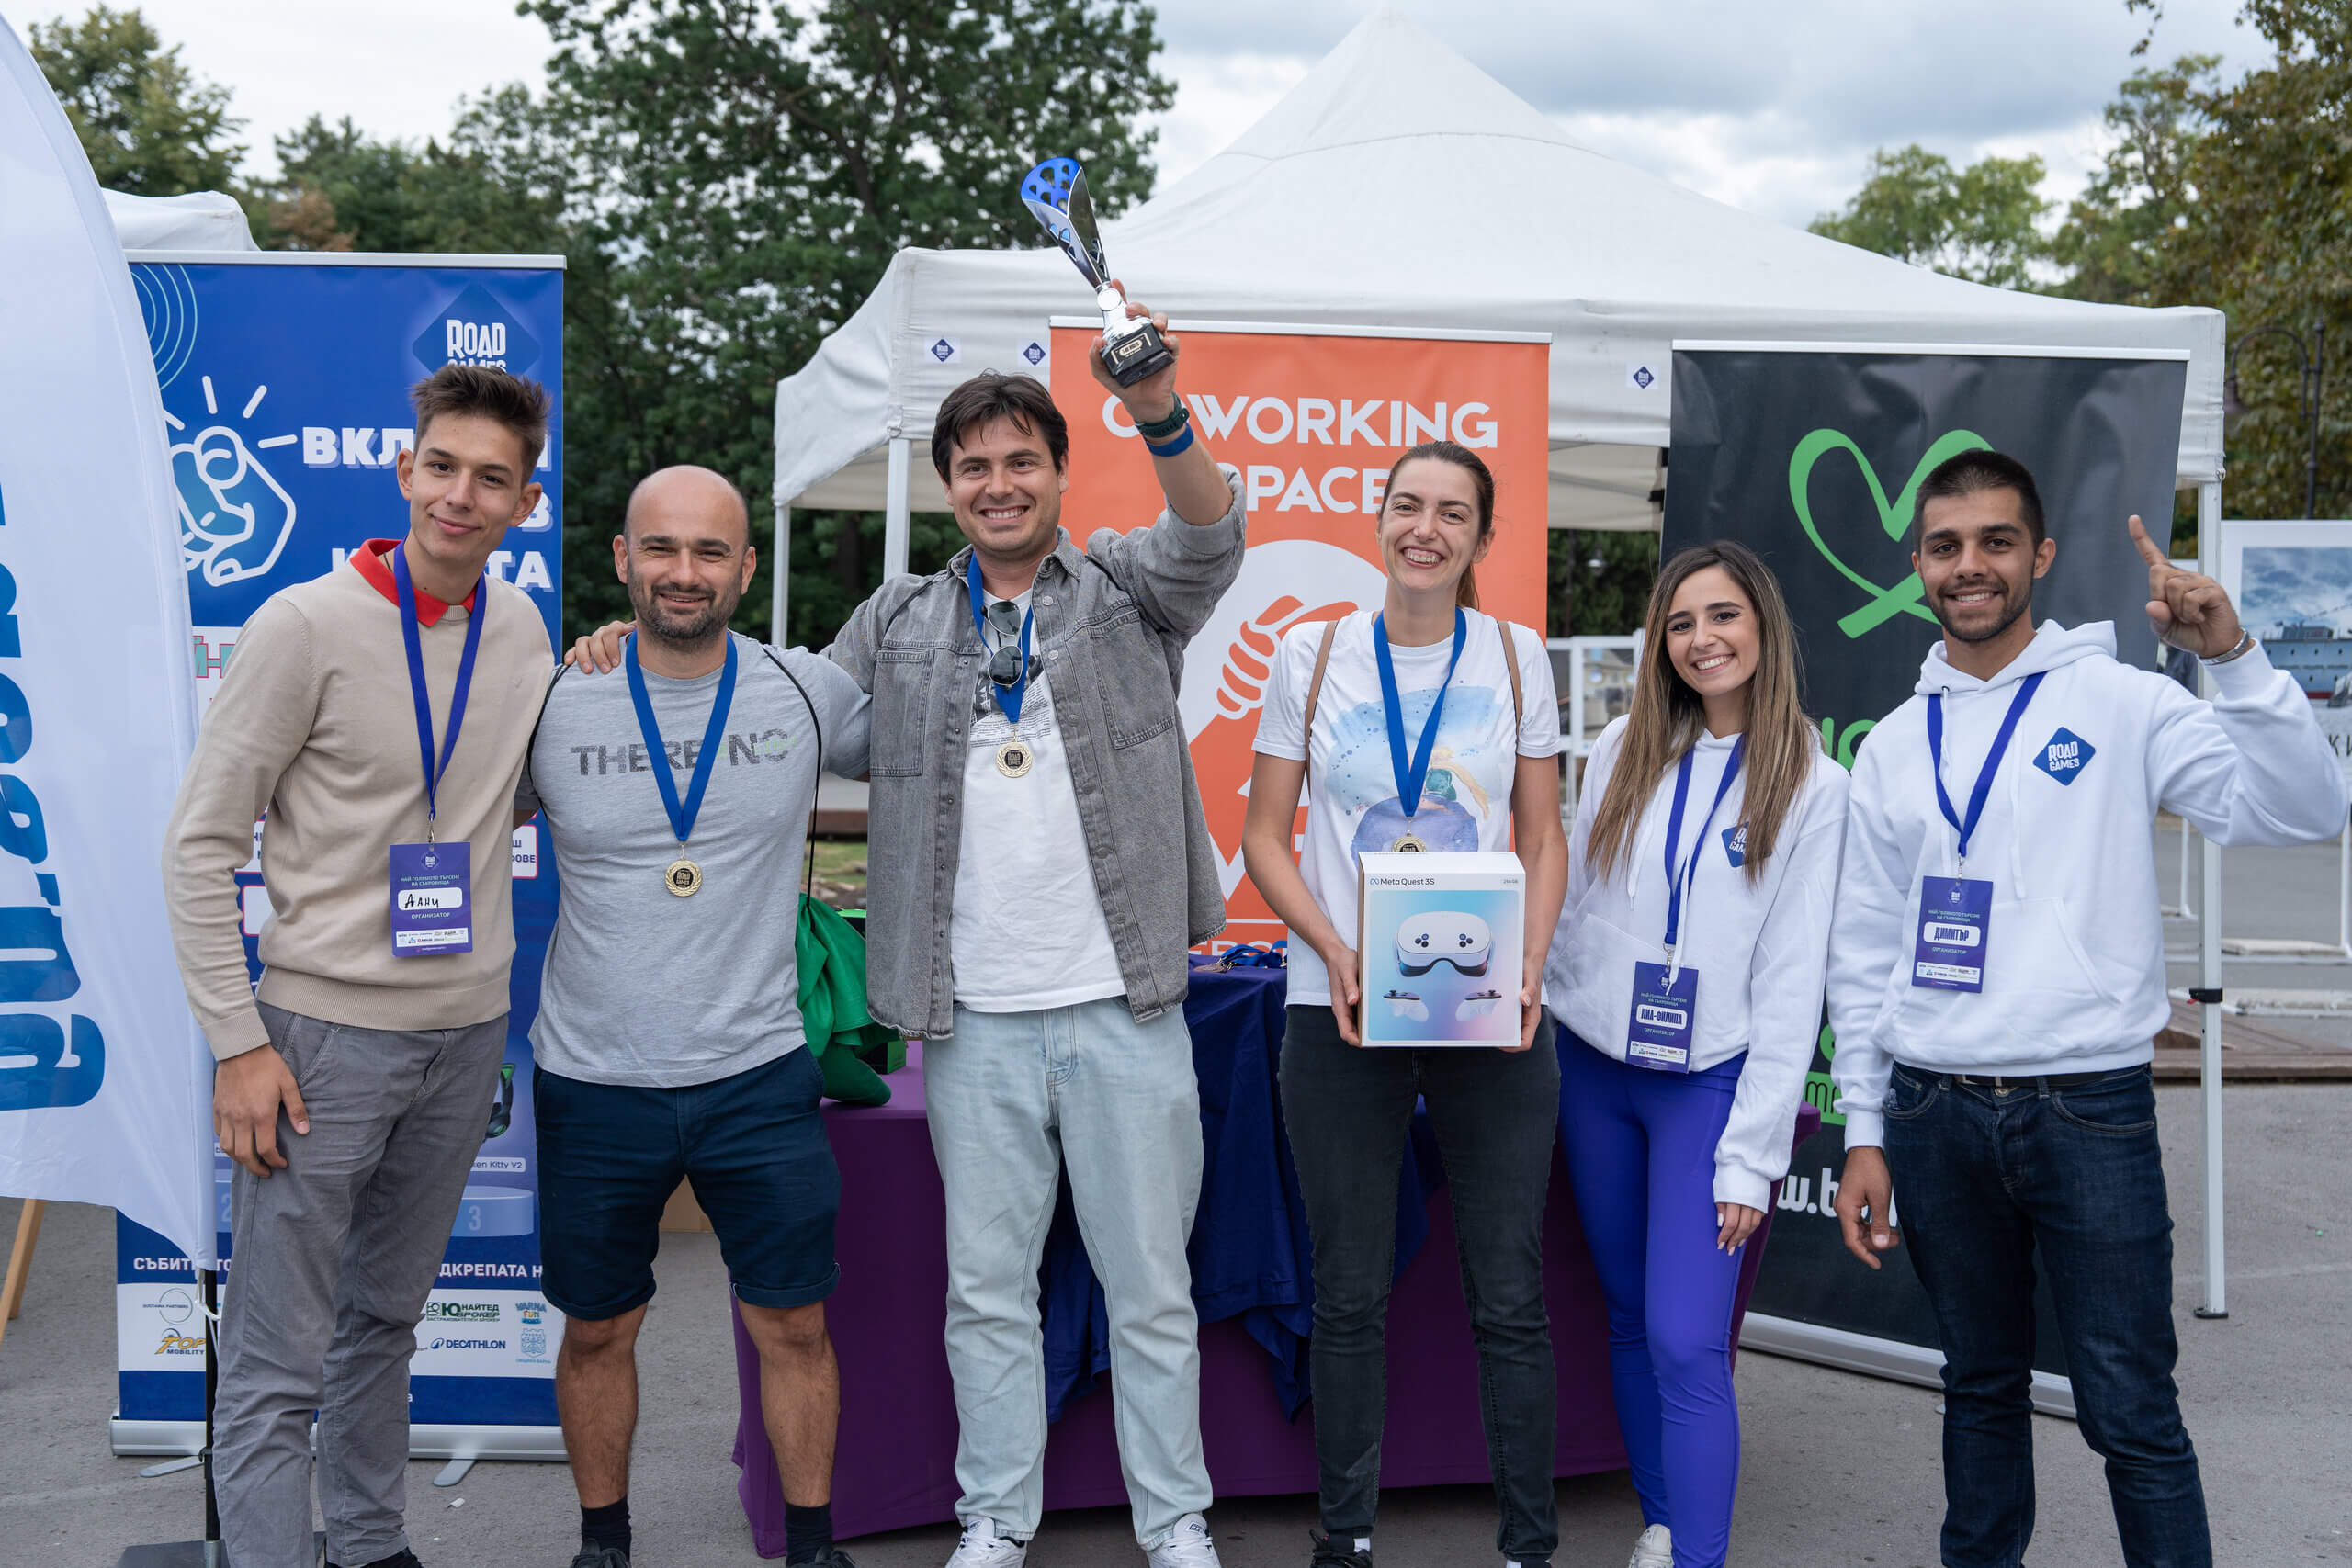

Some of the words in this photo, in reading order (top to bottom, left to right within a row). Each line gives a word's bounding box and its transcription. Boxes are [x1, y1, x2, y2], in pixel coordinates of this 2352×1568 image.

[447, 319, 506, 359] ROAD
[1102, 394, 1498, 448] CWORKING
[1216, 462, 1391, 514] PACE
[2048, 741, 2078, 761] ROAD
[2049, 757, 2080, 772] GAMES
[1401, 877, 1424, 886] Quest
[490, 1161, 509, 1169] Kitty
[511, 1161, 523, 1169] V2
[469, 1205, 481, 1231] 3
[439, 1263, 528, 1278] ДКРЕПАТА
[154, 1337, 206, 1354] TOP
[446, 1339, 506, 1349] DECATHLON
